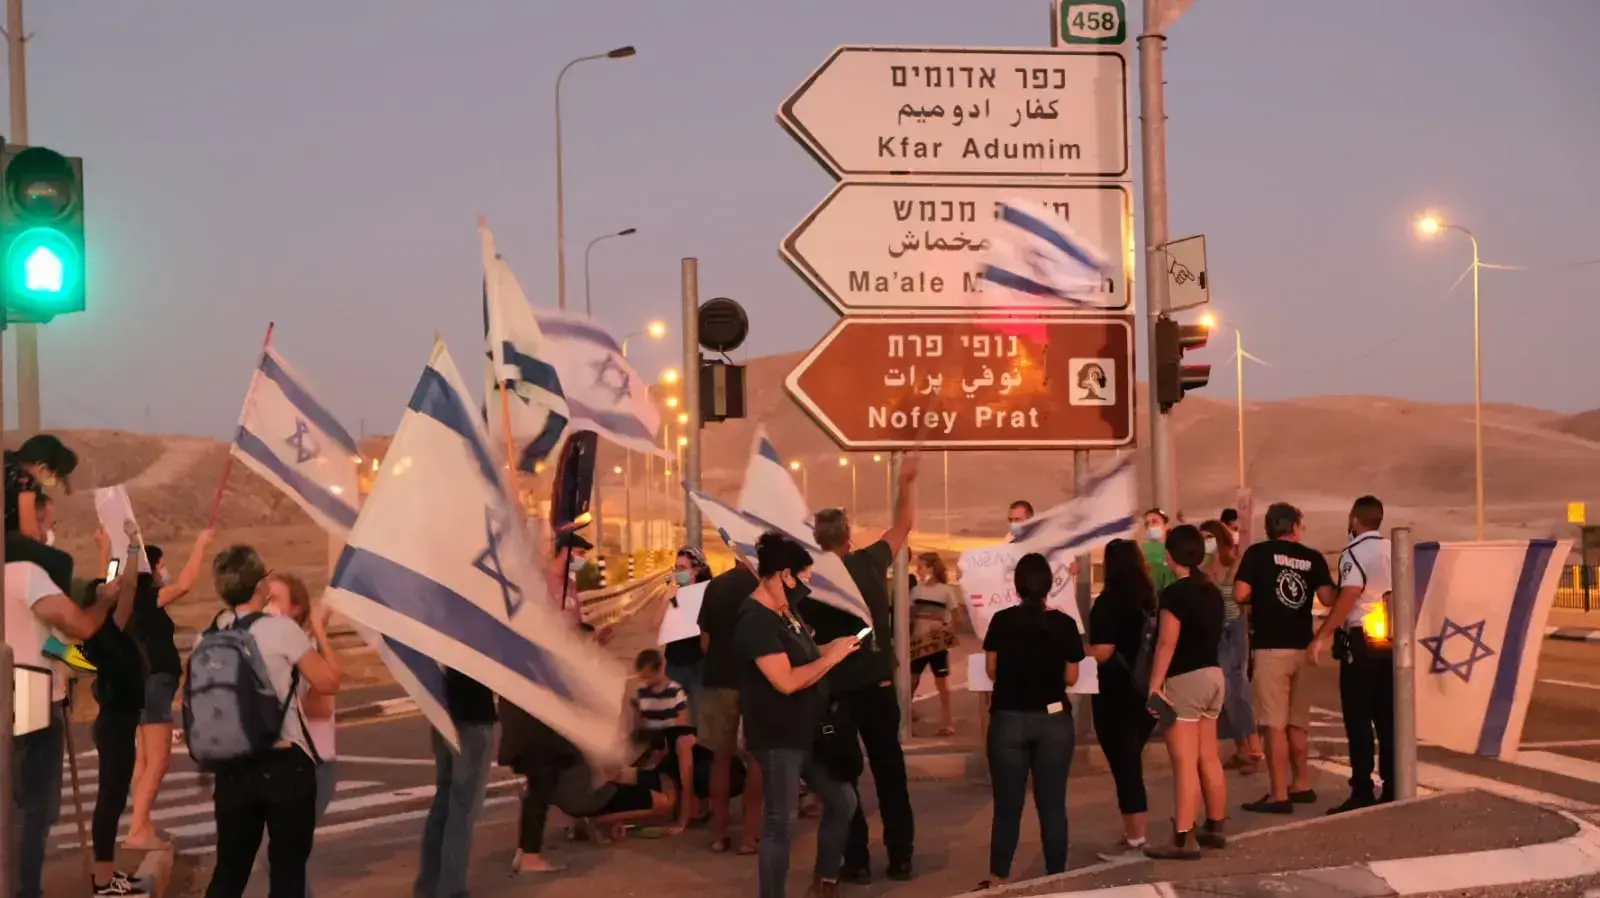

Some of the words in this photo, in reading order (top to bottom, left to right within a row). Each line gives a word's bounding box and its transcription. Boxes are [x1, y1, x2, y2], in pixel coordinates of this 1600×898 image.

[1072, 11, 1115, 31] 458
[890, 65, 996, 89] אדומים
[1014, 67, 1066, 90] כפר
[1009, 98, 1059, 127] كفار
[878, 135, 943, 159] Kfar
[961, 137, 1081, 160] Adumim
[893, 199, 976, 222] מכמש
[848, 270, 944, 293] Ma'ale
[887, 335, 943, 358] פרת
[960, 335, 1018, 358] נופי
[961, 364, 1023, 399] نوفي
[868, 406, 957, 434] Nofey
[975, 406, 1039, 429] Prat
